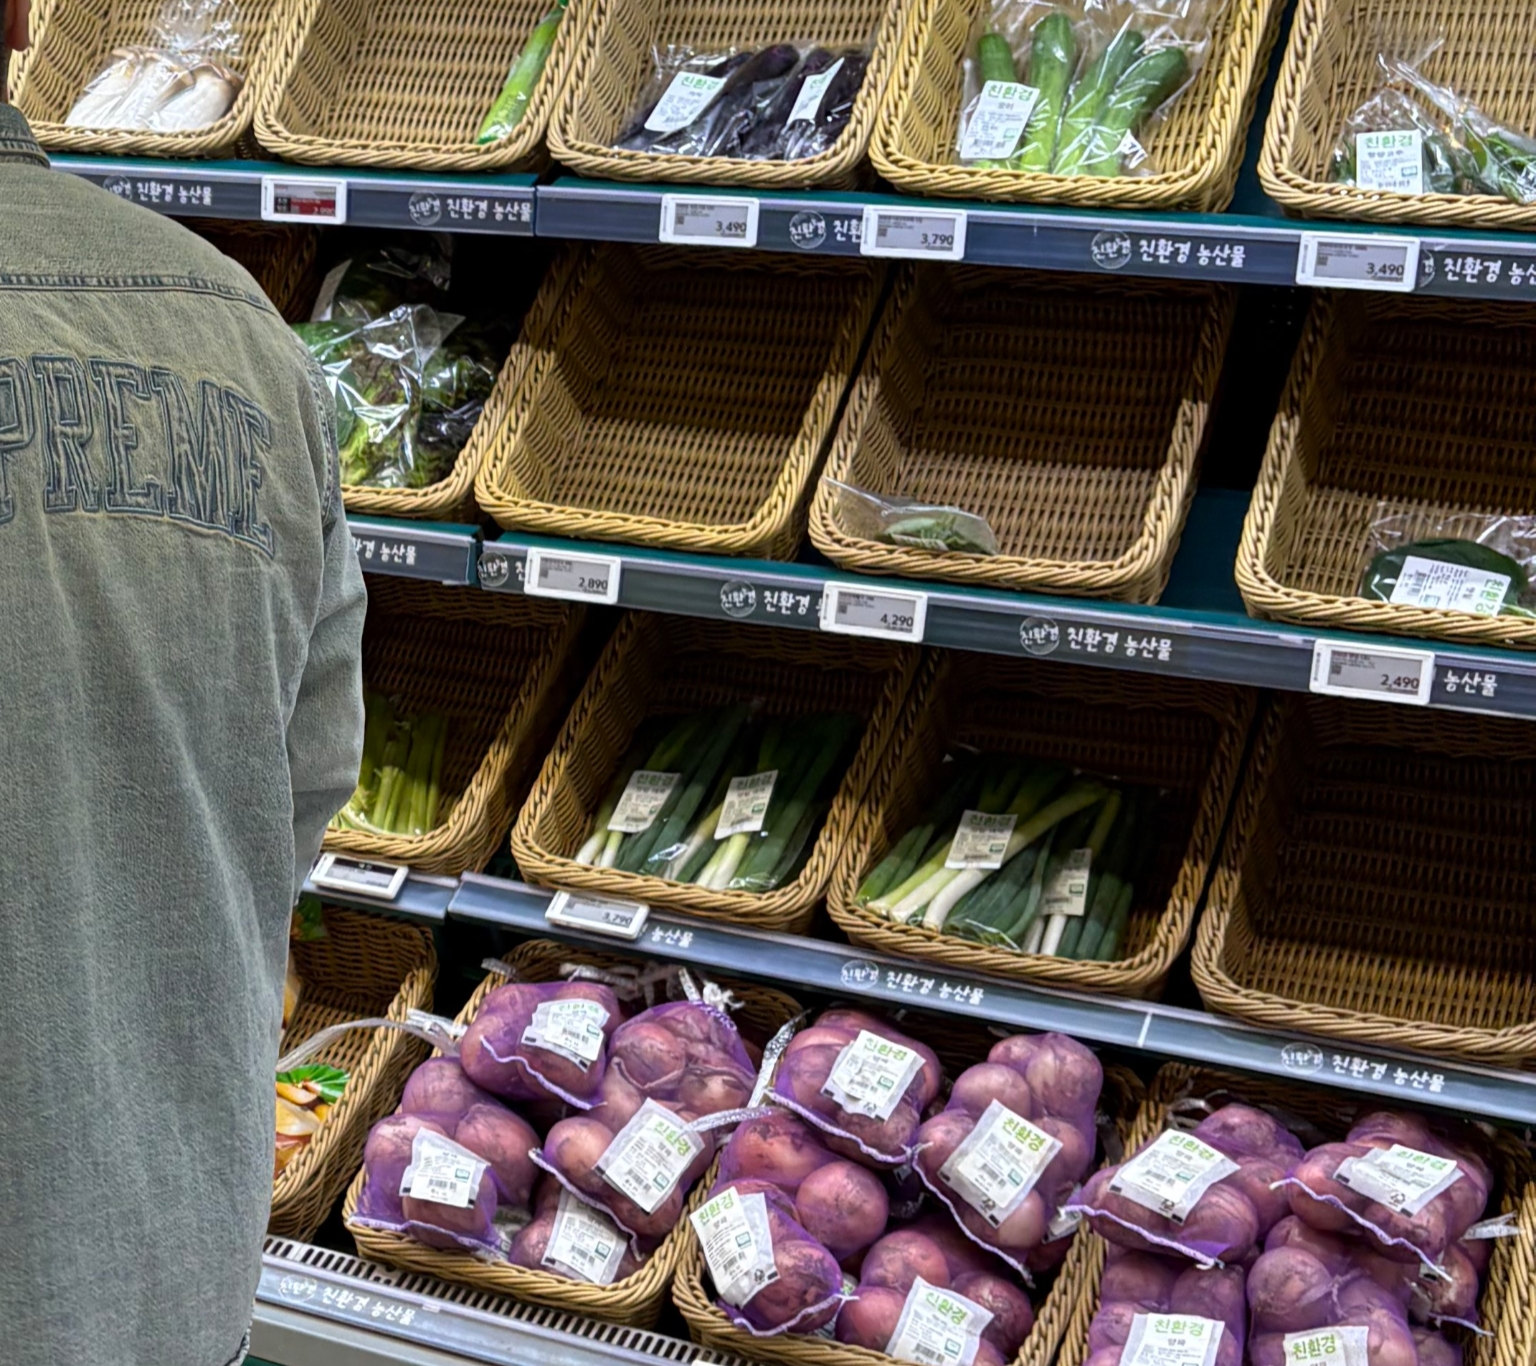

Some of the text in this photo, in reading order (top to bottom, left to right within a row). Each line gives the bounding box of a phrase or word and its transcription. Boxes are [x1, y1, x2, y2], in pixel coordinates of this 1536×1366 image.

[987, 84, 1034, 102] 친환경
[1365, 135, 1413, 149] 친환경
[137, 181, 213, 206] 친환경 농산물
[446, 197, 532, 223] 친환경 농산물
[715, 220, 748, 235] 3,490
[920, 233, 954, 246] 3,790
[1138, 238, 1246, 268] 친환경 농산물
[1366, 261, 1405, 276] 3,490
[1443, 256, 1502, 284] 친환경
[379, 542, 417, 565] 농산물
[763, 590, 811, 616] 친환경
[880, 613, 914, 627] 4,290
[1066, 626, 1173, 661] 친환경 농산물
[1381, 673, 1420, 689] 2,490
[1443, 670, 1498, 697] 농산물
[602, 911, 633, 925] 3,790
[651, 926, 694, 949] 농산물
[886, 971, 985, 1006] 친환경 농산물
[865, 1036, 908, 1062] 친환경
[1332, 1054, 1446, 1093] 친환경 농산물
[654, 1121, 692, 1157] 친환경
[1001, 1116, 1047, 1152] 친환경
[1167, 1135, 1215, 1161] 친환경
[1396, 1148, 1449, 1172] 친환경
[697, 1192, 734, 1225] 친환경
[321, 1286, 417, 1327] 친환경 농산물
[925, 1291, 969, 1326] 친환경
[1154, 1317, 1206, 1338] 친환경
[1292, 1333, 1337, 1361] 친환경
